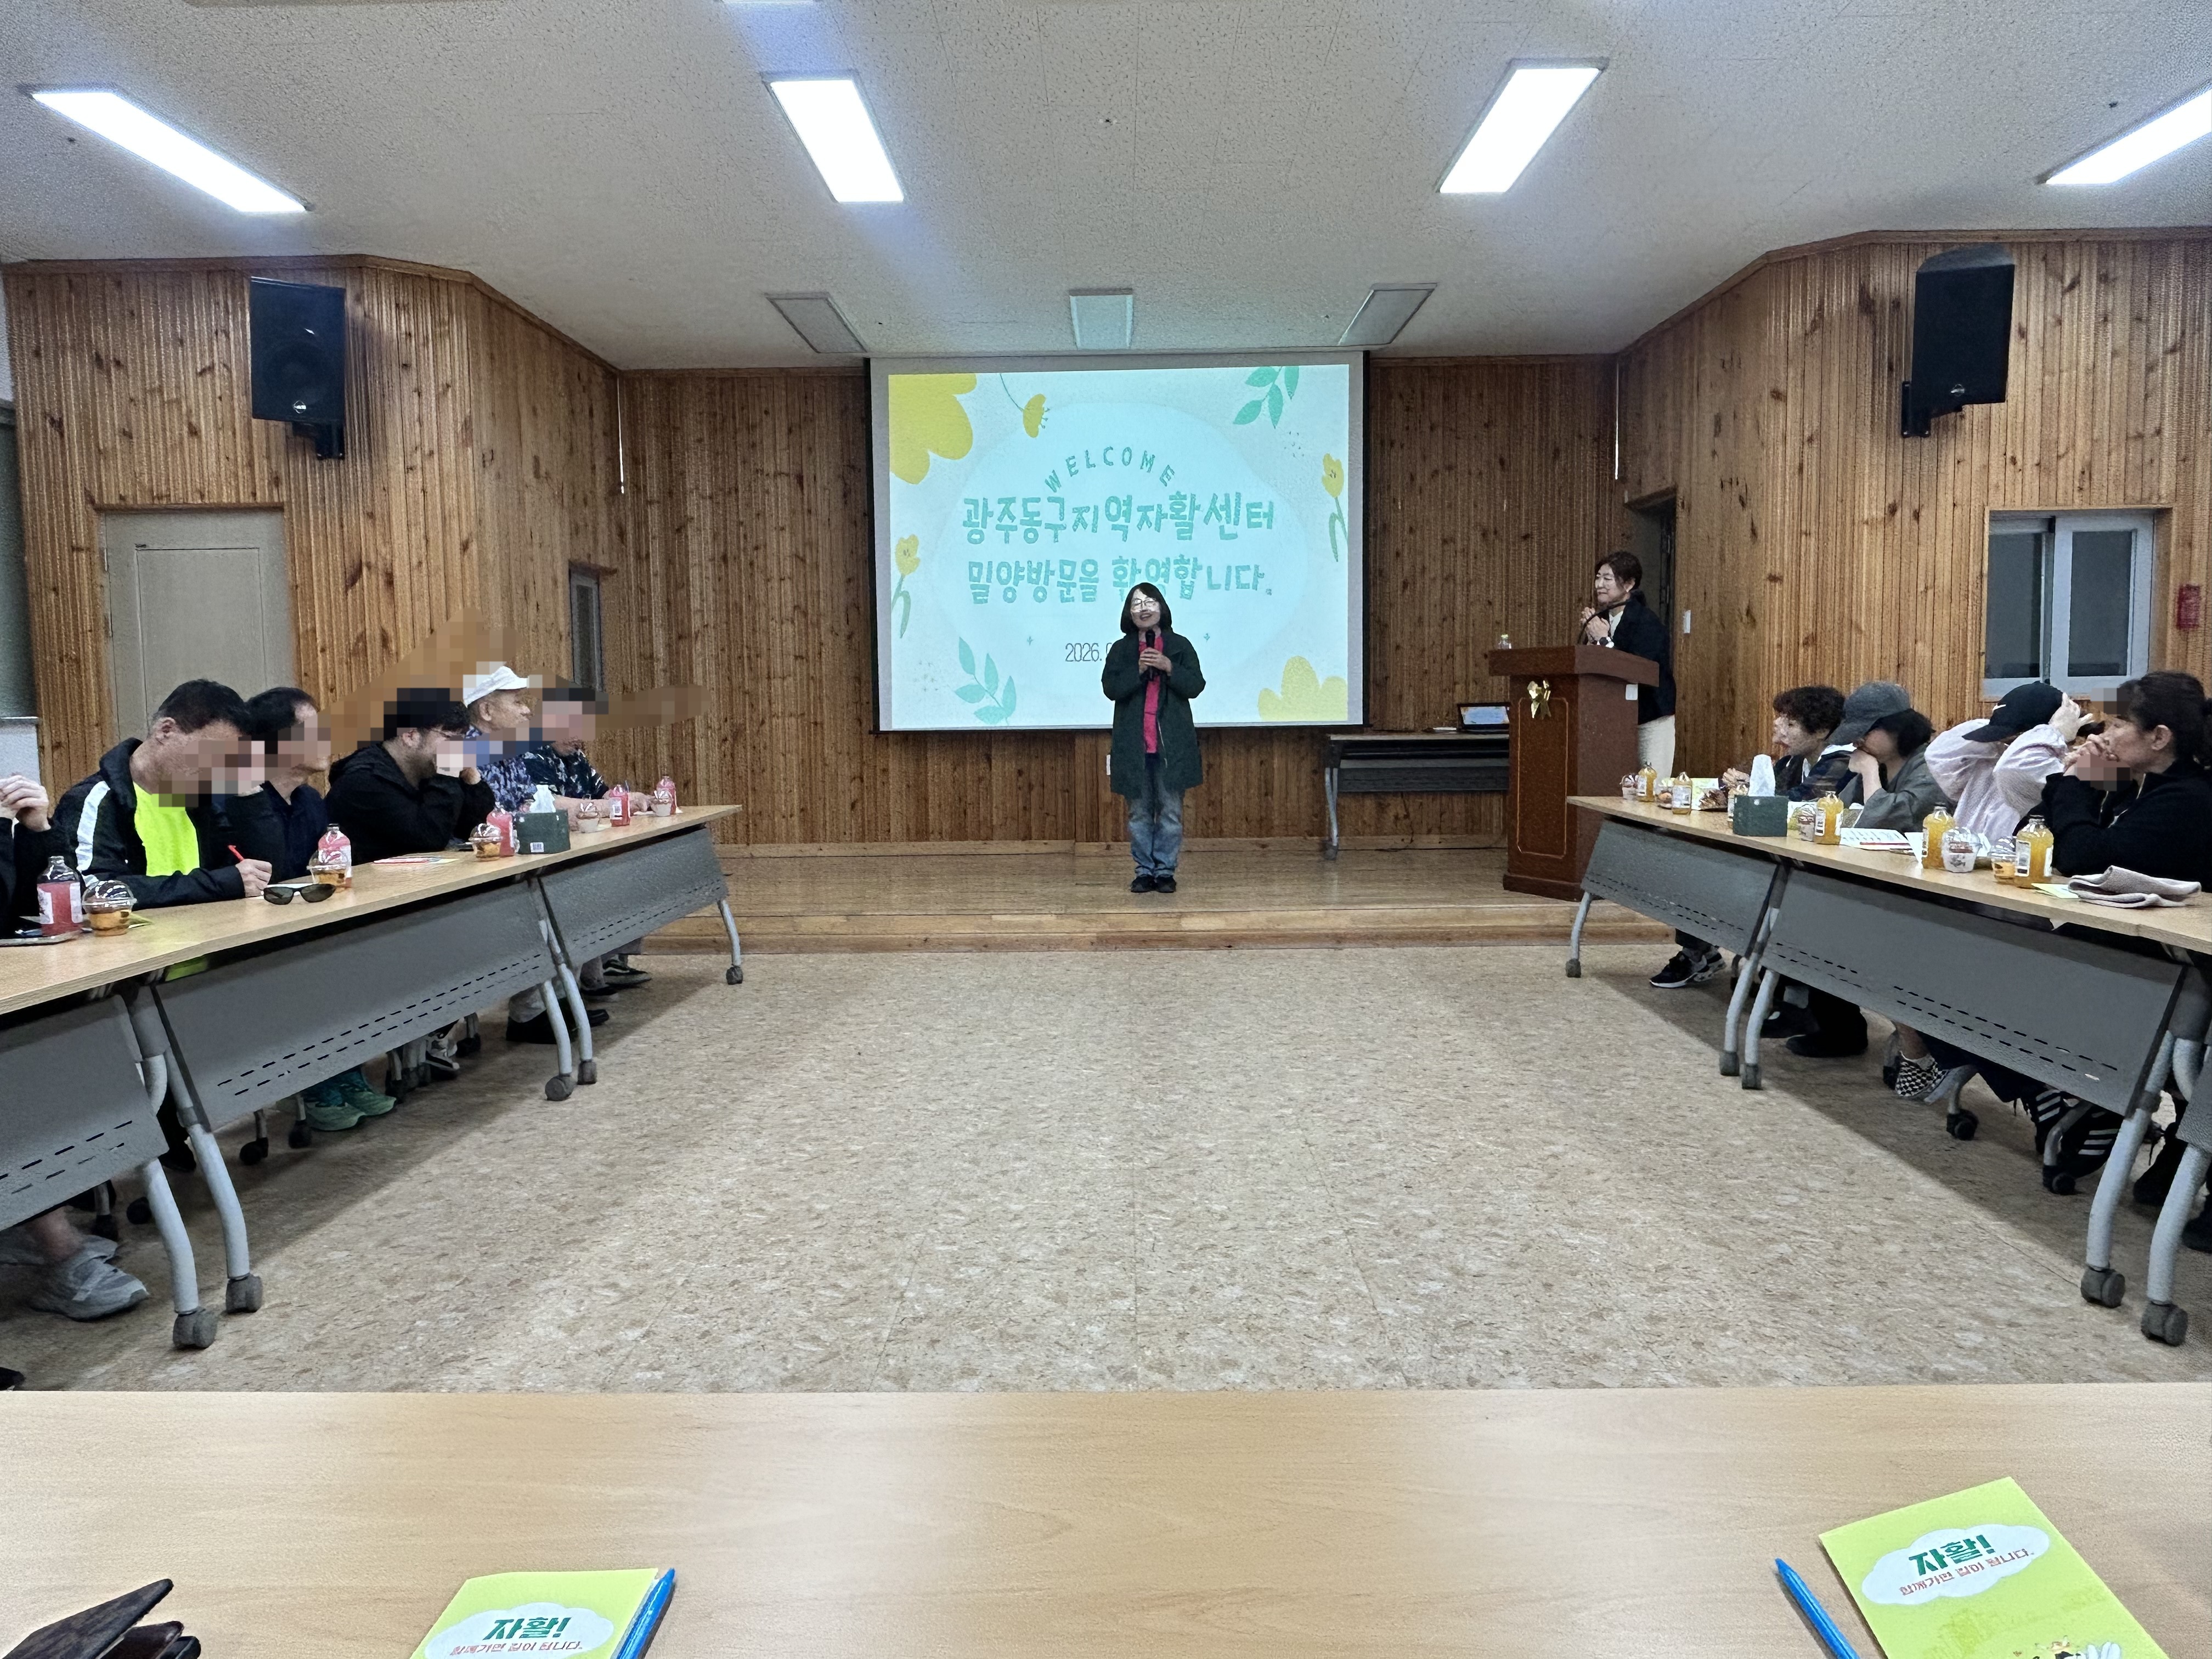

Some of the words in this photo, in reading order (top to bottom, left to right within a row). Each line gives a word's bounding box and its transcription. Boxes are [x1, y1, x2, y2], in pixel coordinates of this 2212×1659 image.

[1045, 446, 1175, 493] WELCOME
[962, 490, 1274, 545] 광주동구지역자활센터
[968, 558, 1099, 604] 밀양방문을
[1909, 1534, 1996, 1576] 자활!
[482, 1617, 572, 1641] 자활!
